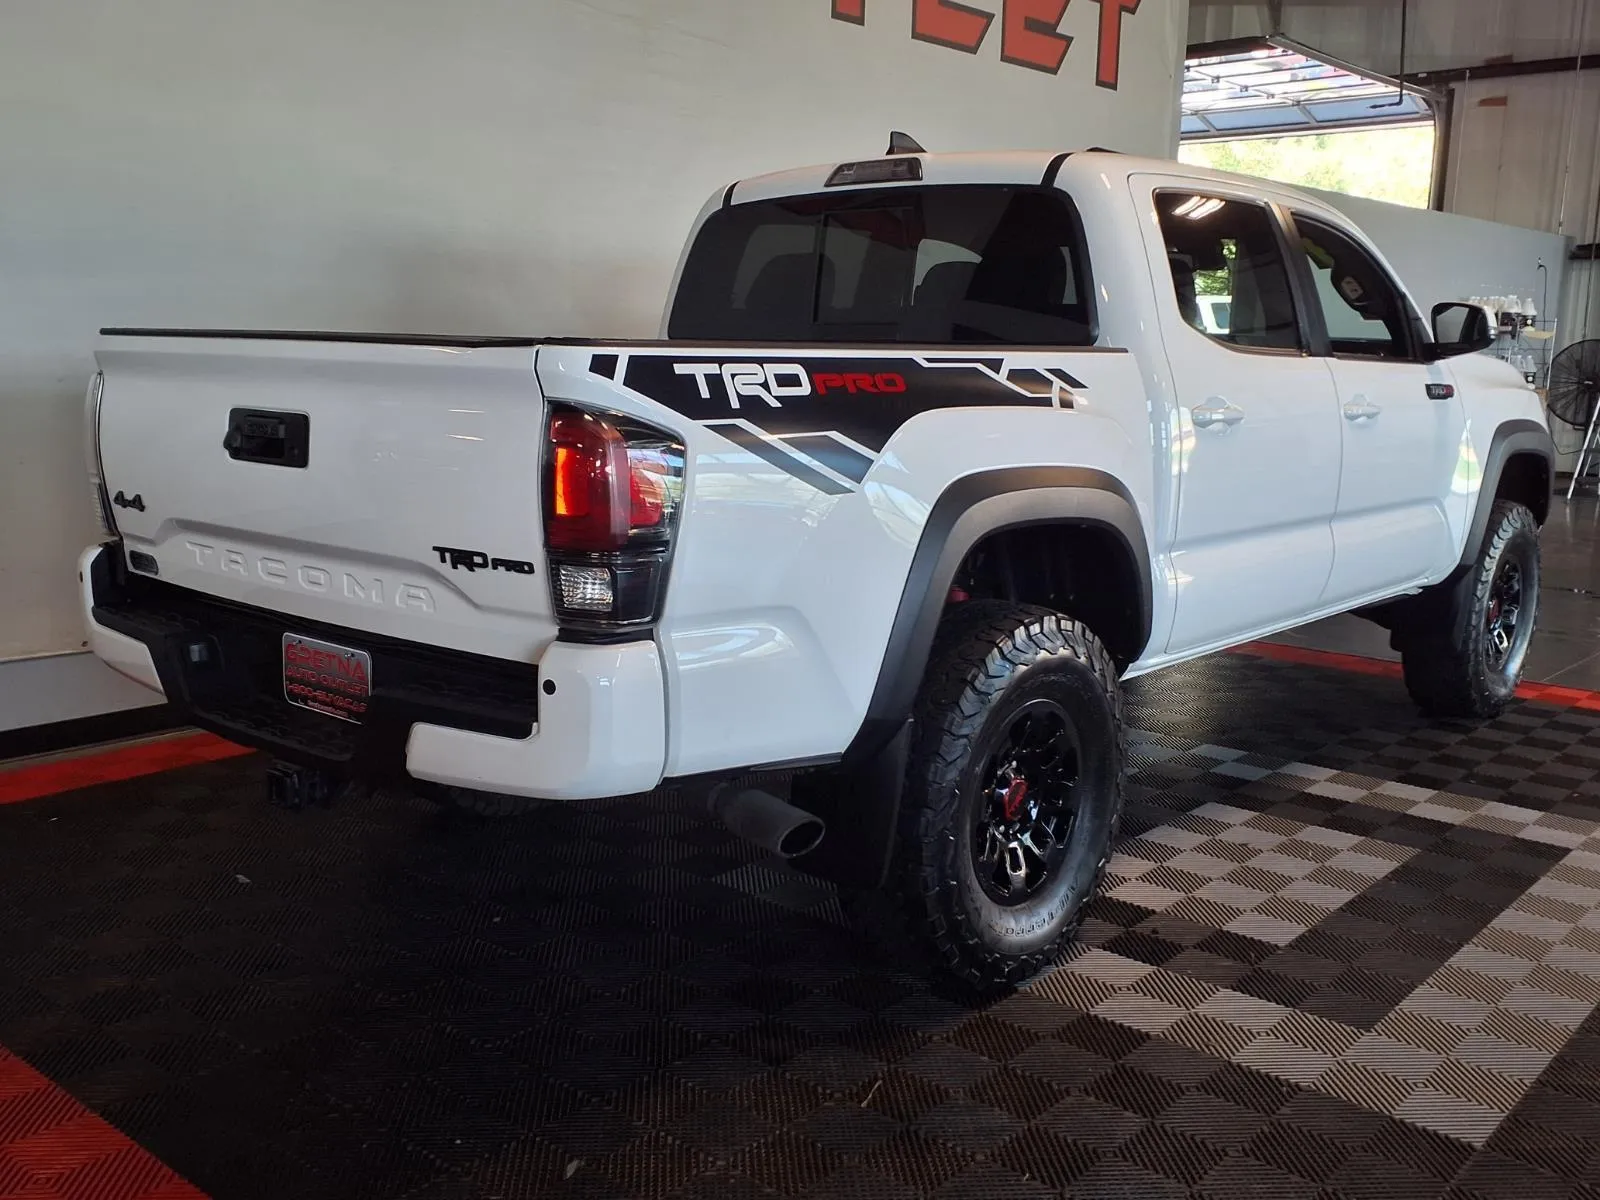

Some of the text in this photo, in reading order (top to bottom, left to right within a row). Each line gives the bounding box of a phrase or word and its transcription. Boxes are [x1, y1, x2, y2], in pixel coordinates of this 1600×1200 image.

[673, 363, 907, 409] TRD PRO
[185, 540, 437, 613] TACOMA
[432, 546, 535, 574] TRD PRO
[285, 643, 368, 682] GRETNA
